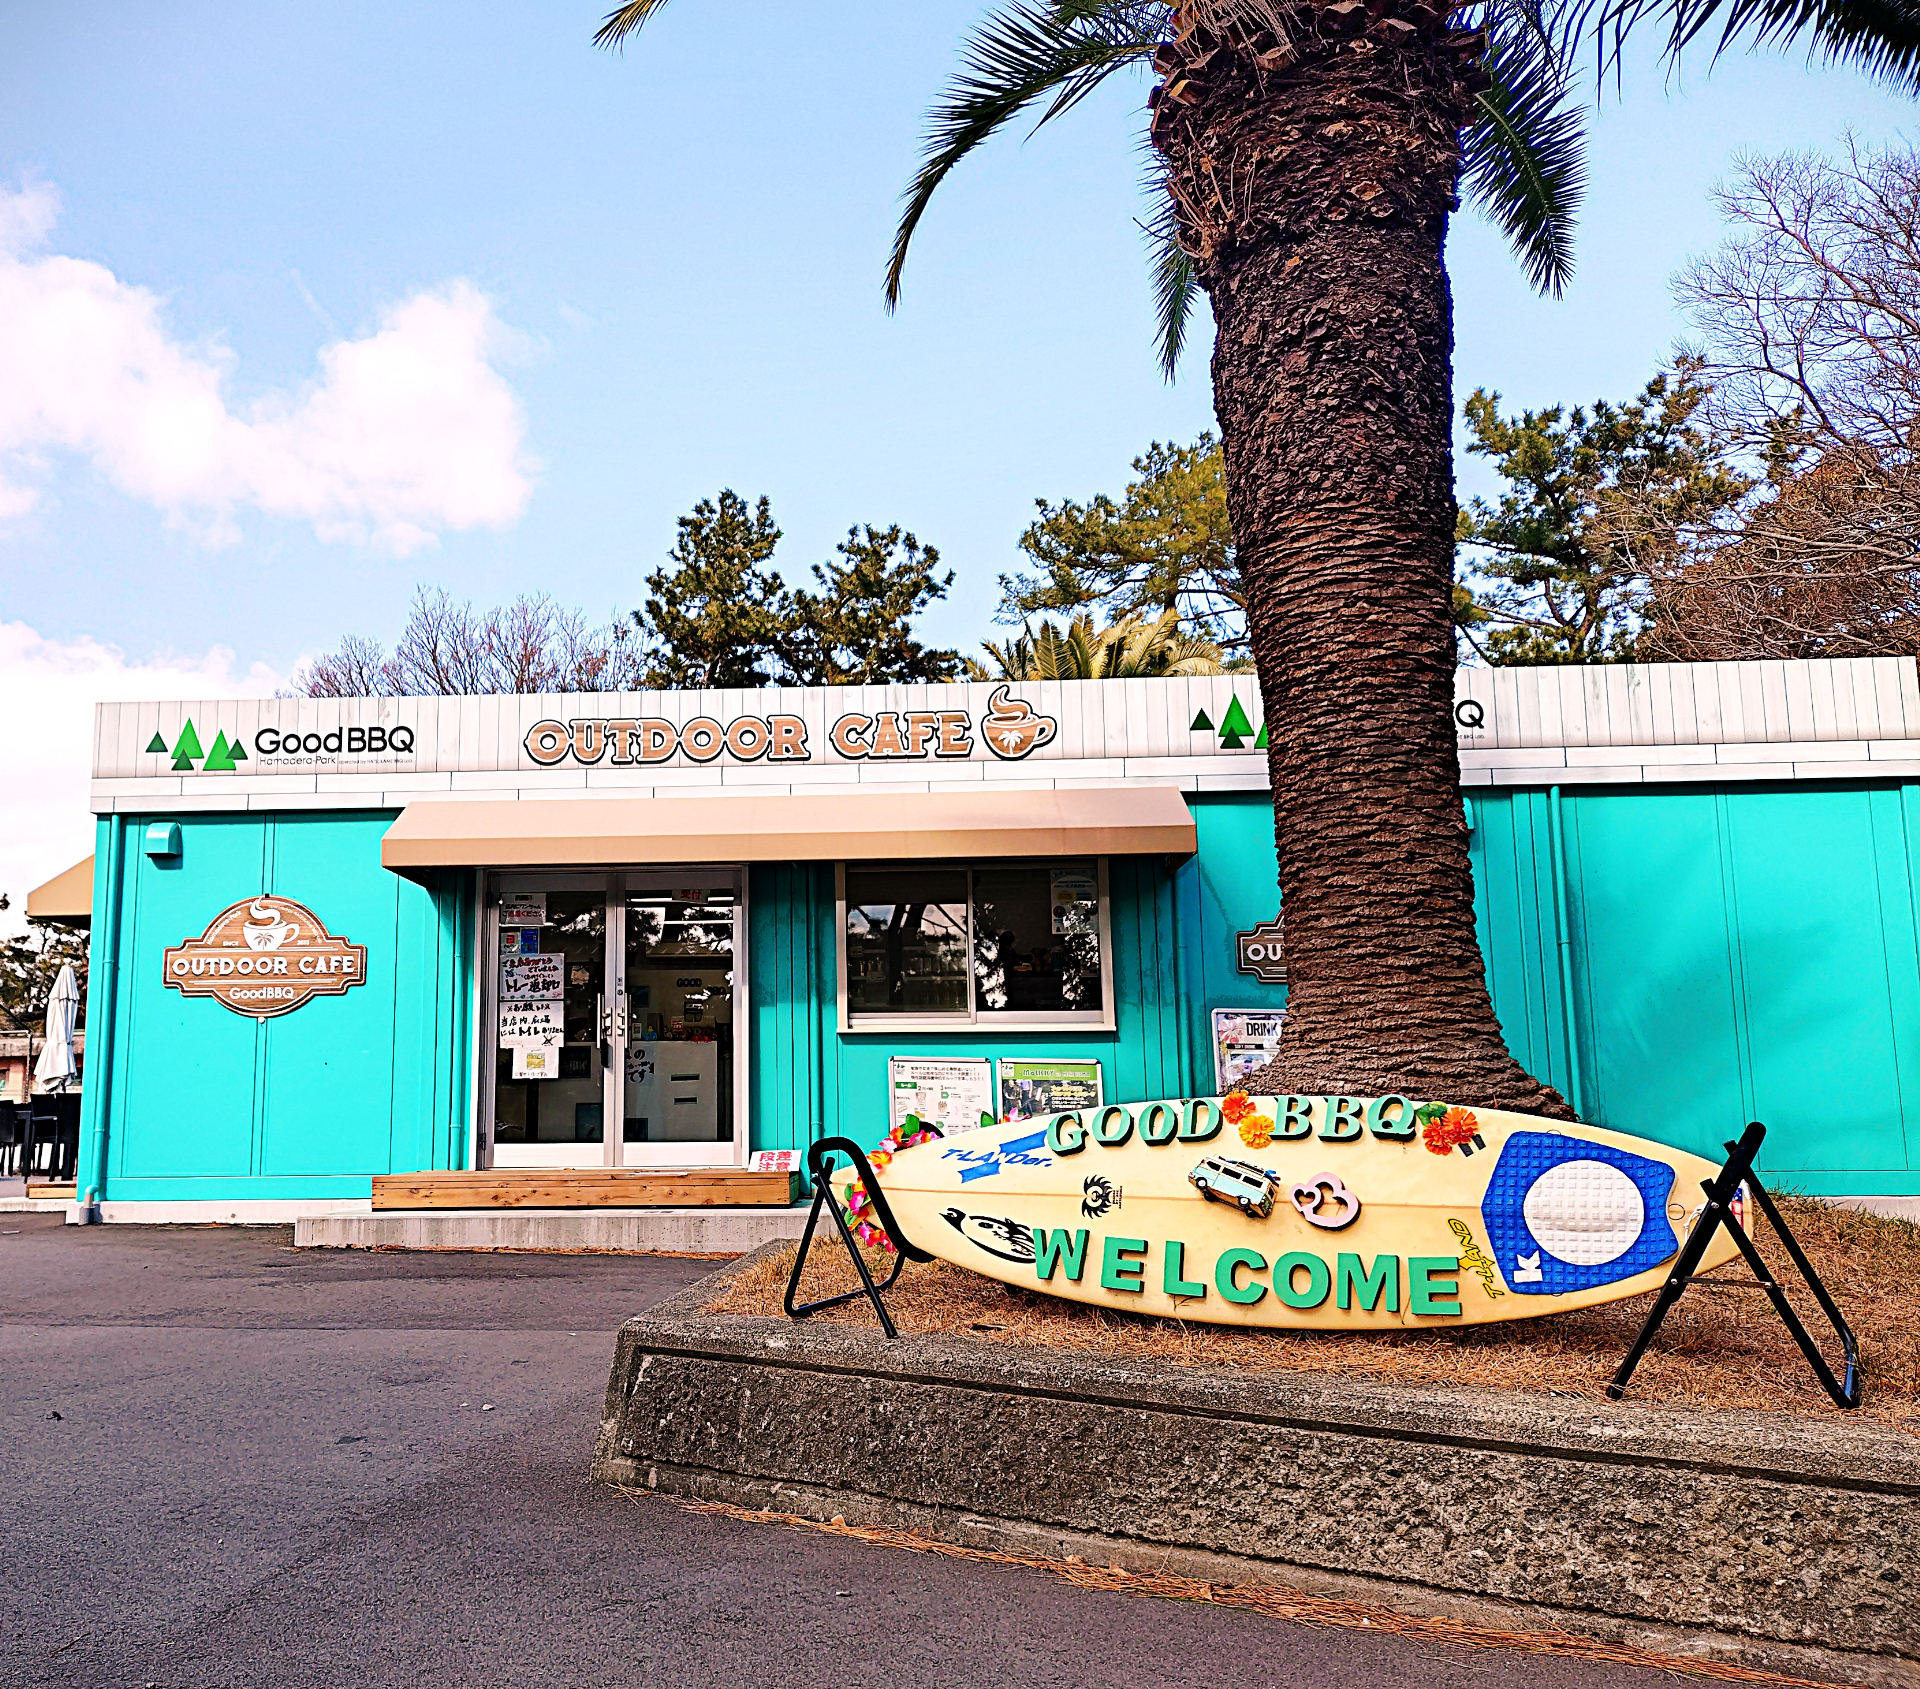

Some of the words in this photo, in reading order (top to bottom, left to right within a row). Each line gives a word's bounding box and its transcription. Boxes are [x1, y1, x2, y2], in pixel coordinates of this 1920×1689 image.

[524, 715, 811, 764] OUTDOOR
[829, 711, 974, 760] CAFE
[260, 756, 336, 765] Hamadera-Park
[1246, 943, 1286, 961] OU
[172, 957, 288, 976] OUTDOOR
[299, 955, 355, 974] CAFE
[229, 987, 294, 1000] GoodBBQ
[1246, 1022, 1279, 1036] DRINK
[1046, 1097, 1224, 1156] GOOD
[1270, 1094, 1416, 1142] BBQ
[1033, 1228, 1463, 1316] WELCOME
